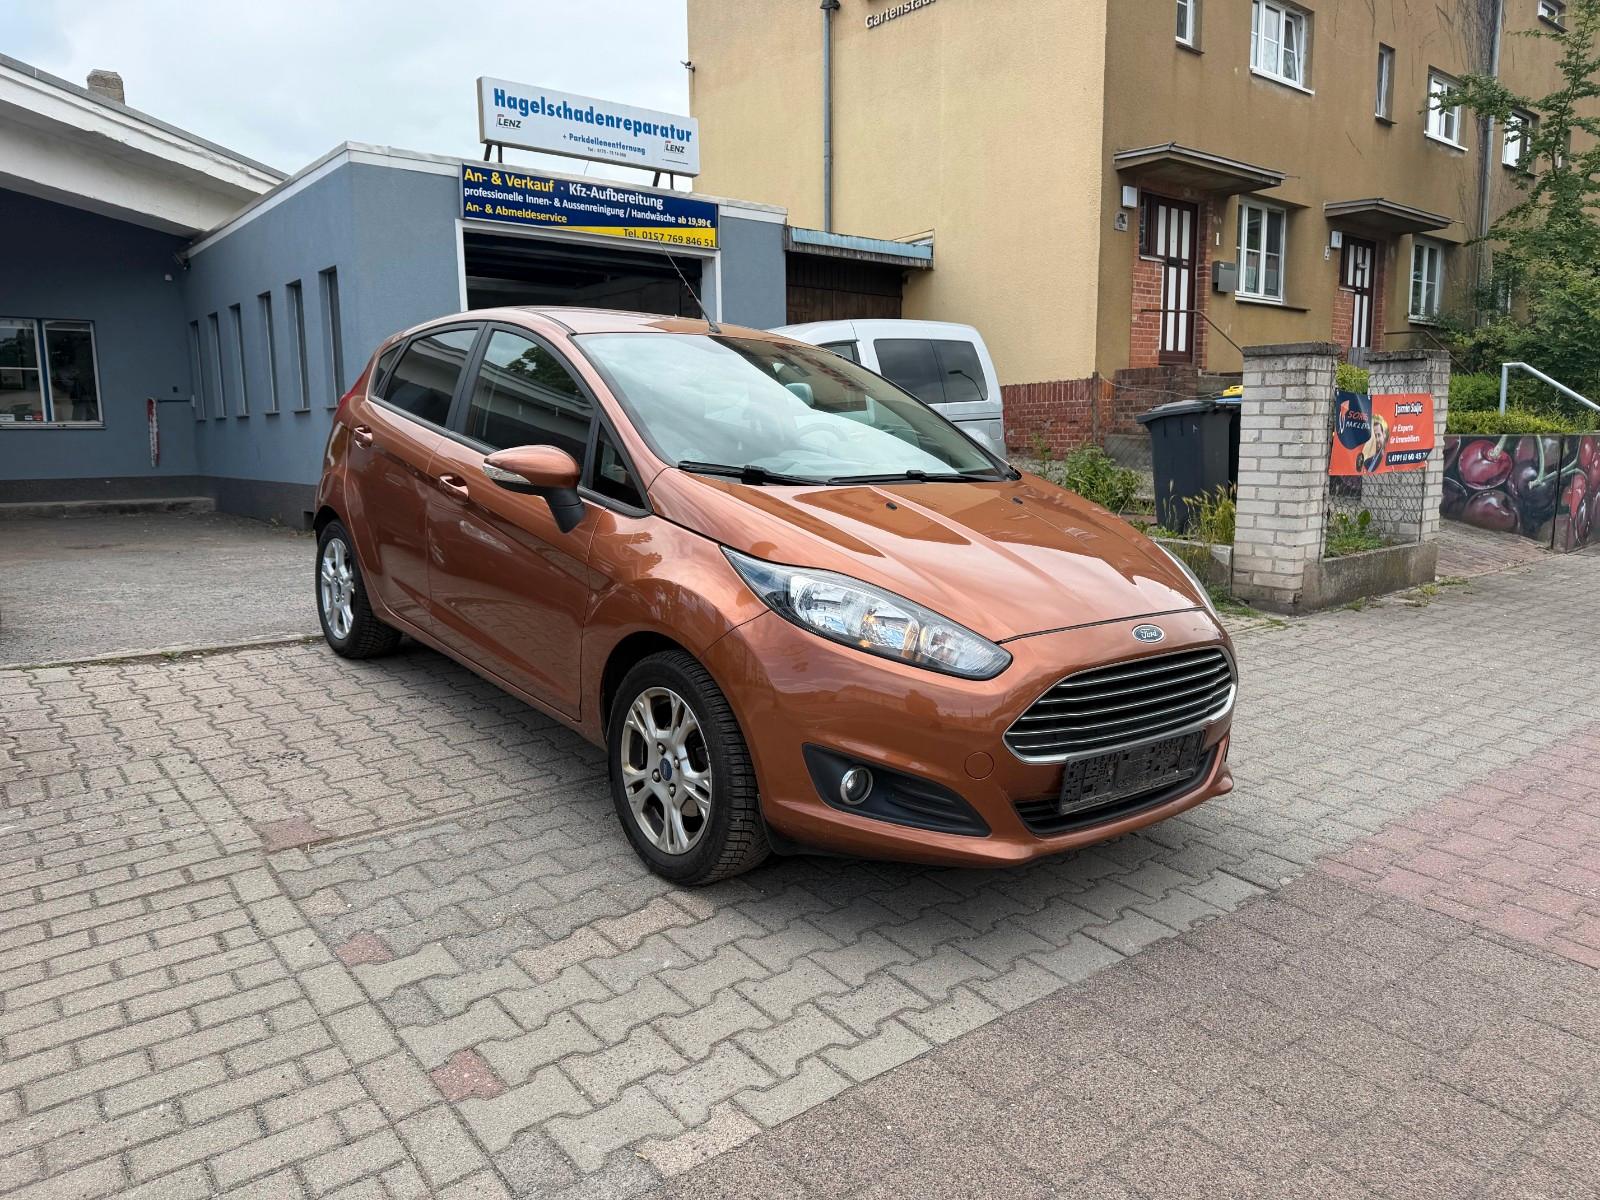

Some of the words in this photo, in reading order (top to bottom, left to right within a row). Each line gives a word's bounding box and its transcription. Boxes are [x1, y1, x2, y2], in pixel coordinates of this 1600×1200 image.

[493, 87, 692, 142] Hagelschadenreparatur
[498, 117, 522, 129] LENZ
[665, 143, 685, 154] LENZ
[464, 168, 488, 183] An-
[491, 171, 502, 186] &
[504, 173, 555, 193] Verkauf
[568, 182, 664, 211] Kfz-Aufbereitung
[464, 187, 524, 202] professionelle
[525, 194, 552, 206] Innen-
[553, 197, 561, 207] &
[562, 199, 625, 218] Aussenreinigung
[631, 208, 676, 224] Handwäsche
[677, 215, 686, 225] ab
[465, 201, 483, 213] An-
[484, 203, 494, 214] &
[495, 205, 568, 223] Abmeldeservice
[624, 228, 640, 239] Tel.
[642, 230, 665, 242] 0157
[667, 233, 684, 244] 769
[686, 236, 702, 246] 846
[704, 238, 714, 248] 51
